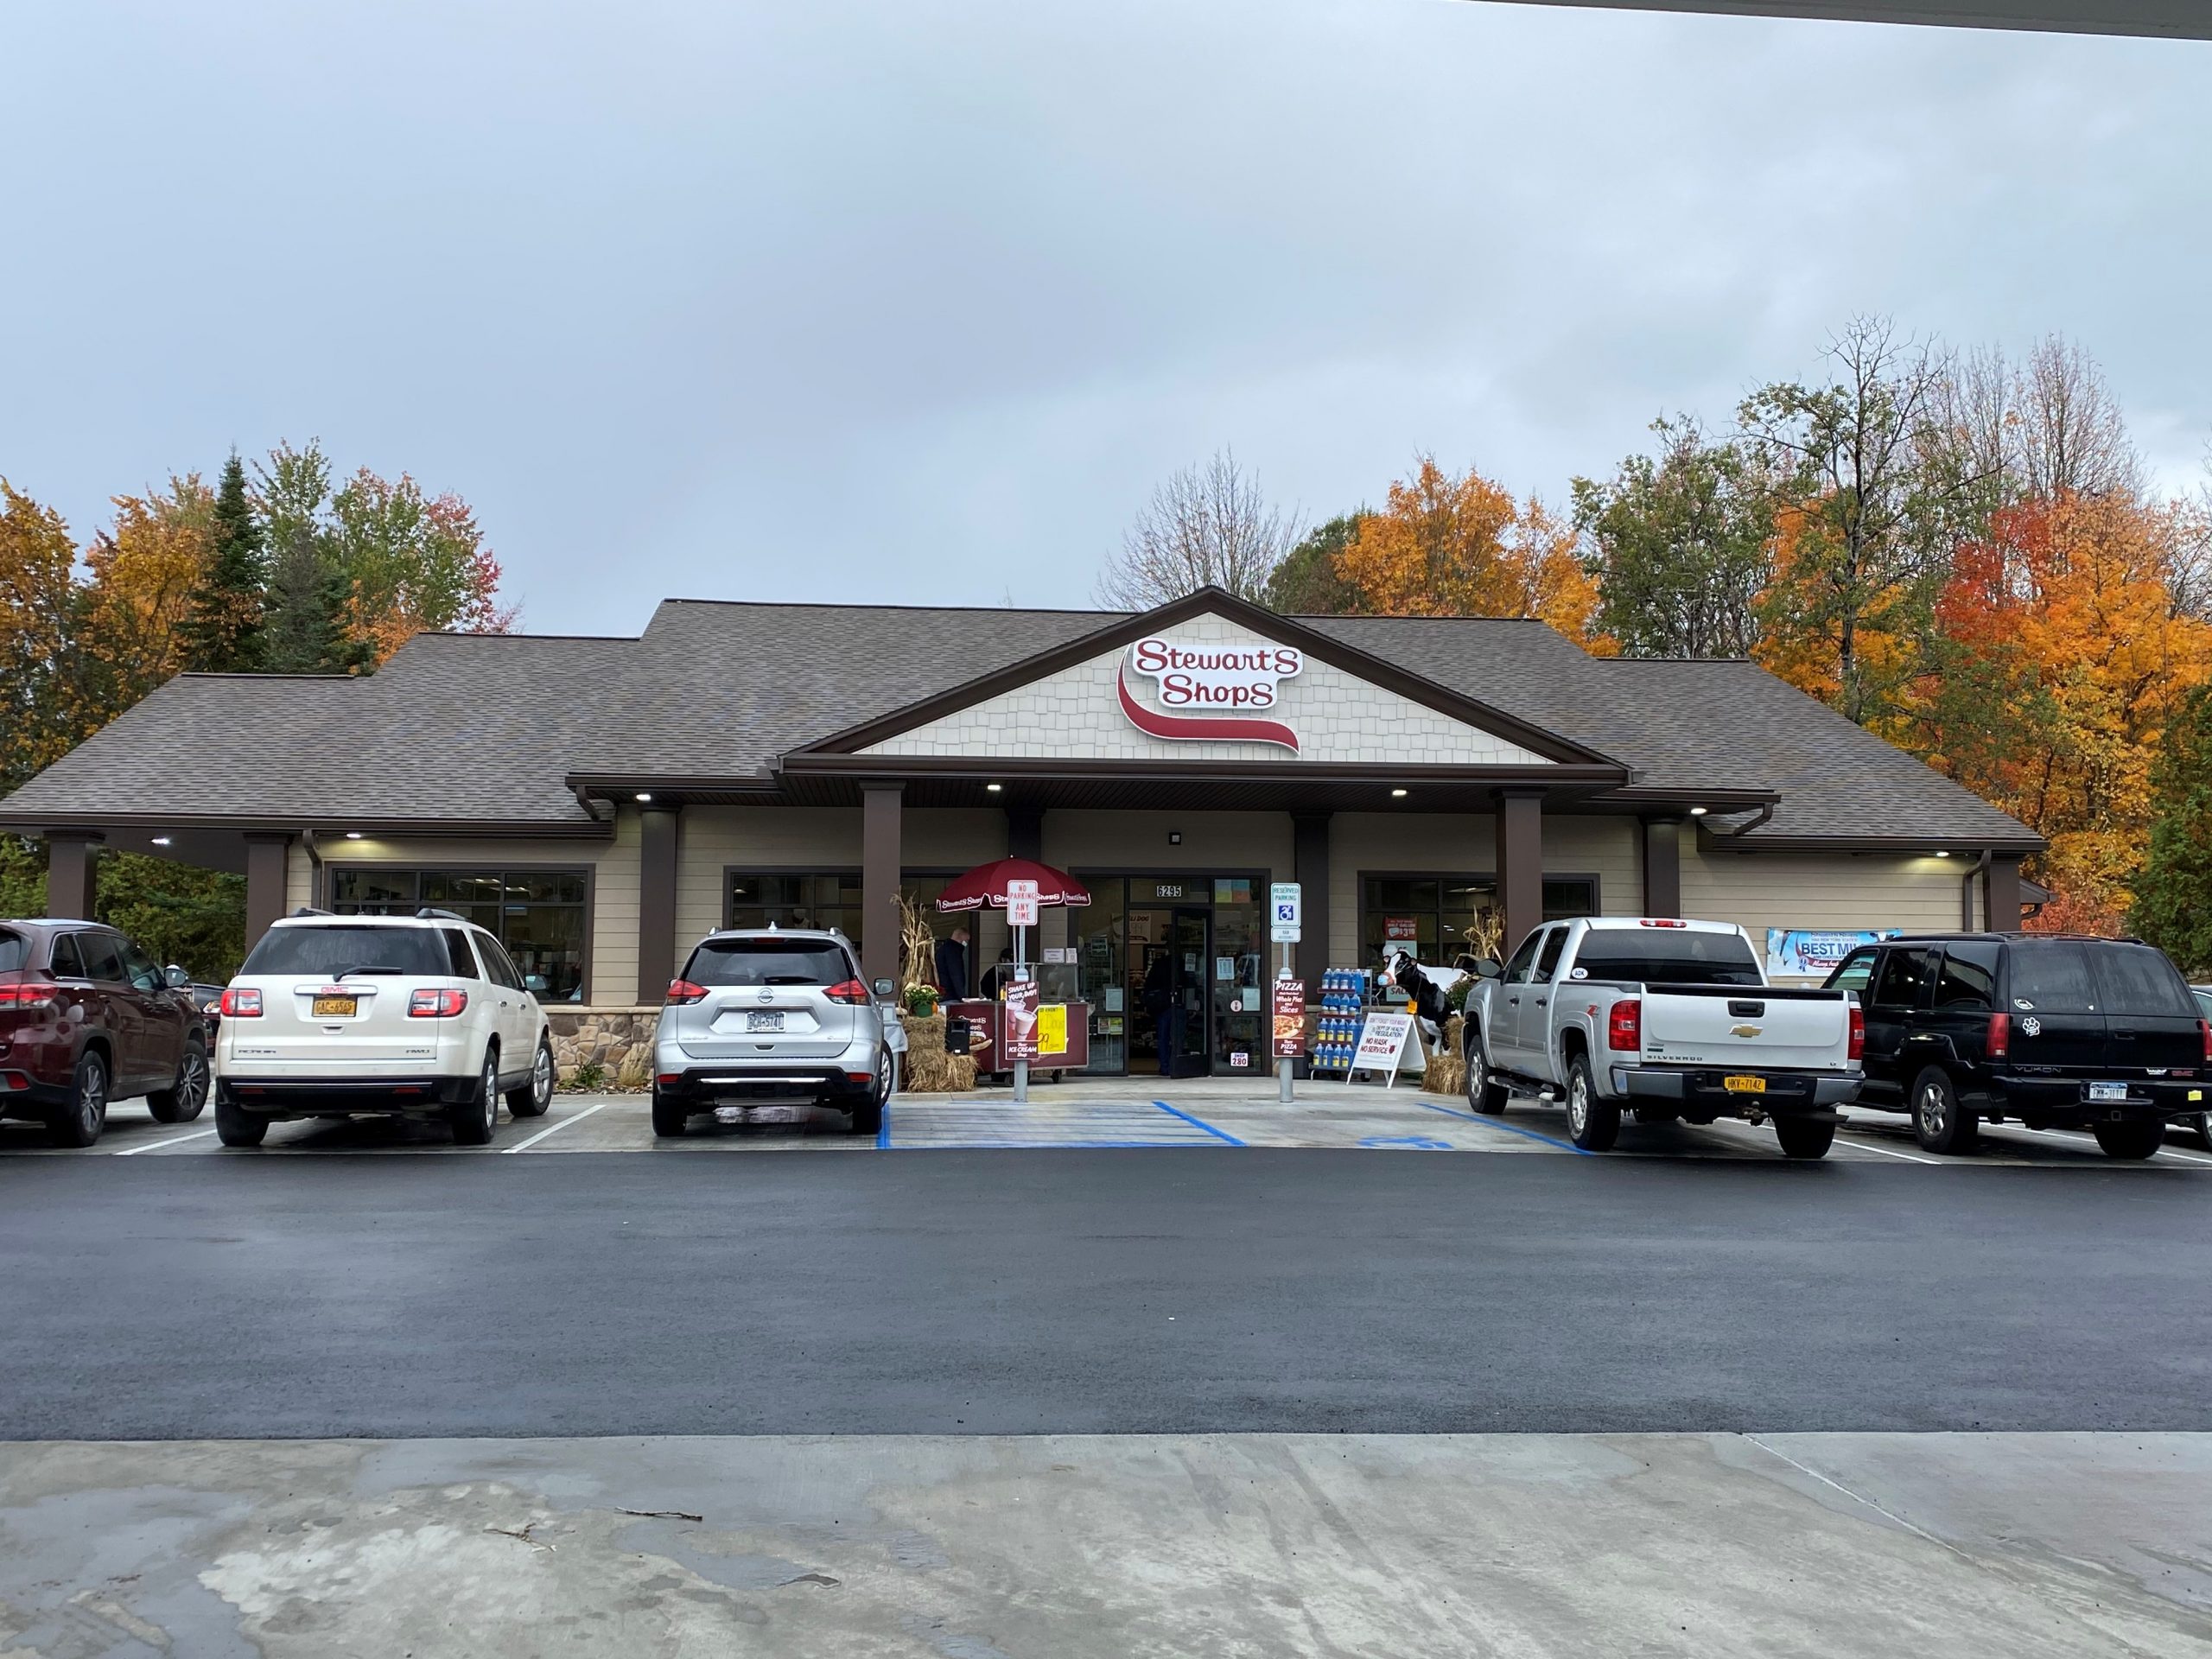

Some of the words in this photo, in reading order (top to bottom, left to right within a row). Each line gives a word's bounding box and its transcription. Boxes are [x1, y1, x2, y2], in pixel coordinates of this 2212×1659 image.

[1158, 886, 1180, 896] 6295
[1802, 943, 1834, 955] BEST
[1838, 943, 1858, 955] MI
[1007, 984, 1026, 994] SHAKE
[1274, 980, 1302, 991] PIZZA
[1390, 987, 1408, 995] SAL
[1367, 1046, 1388, 1054] SERVICE
